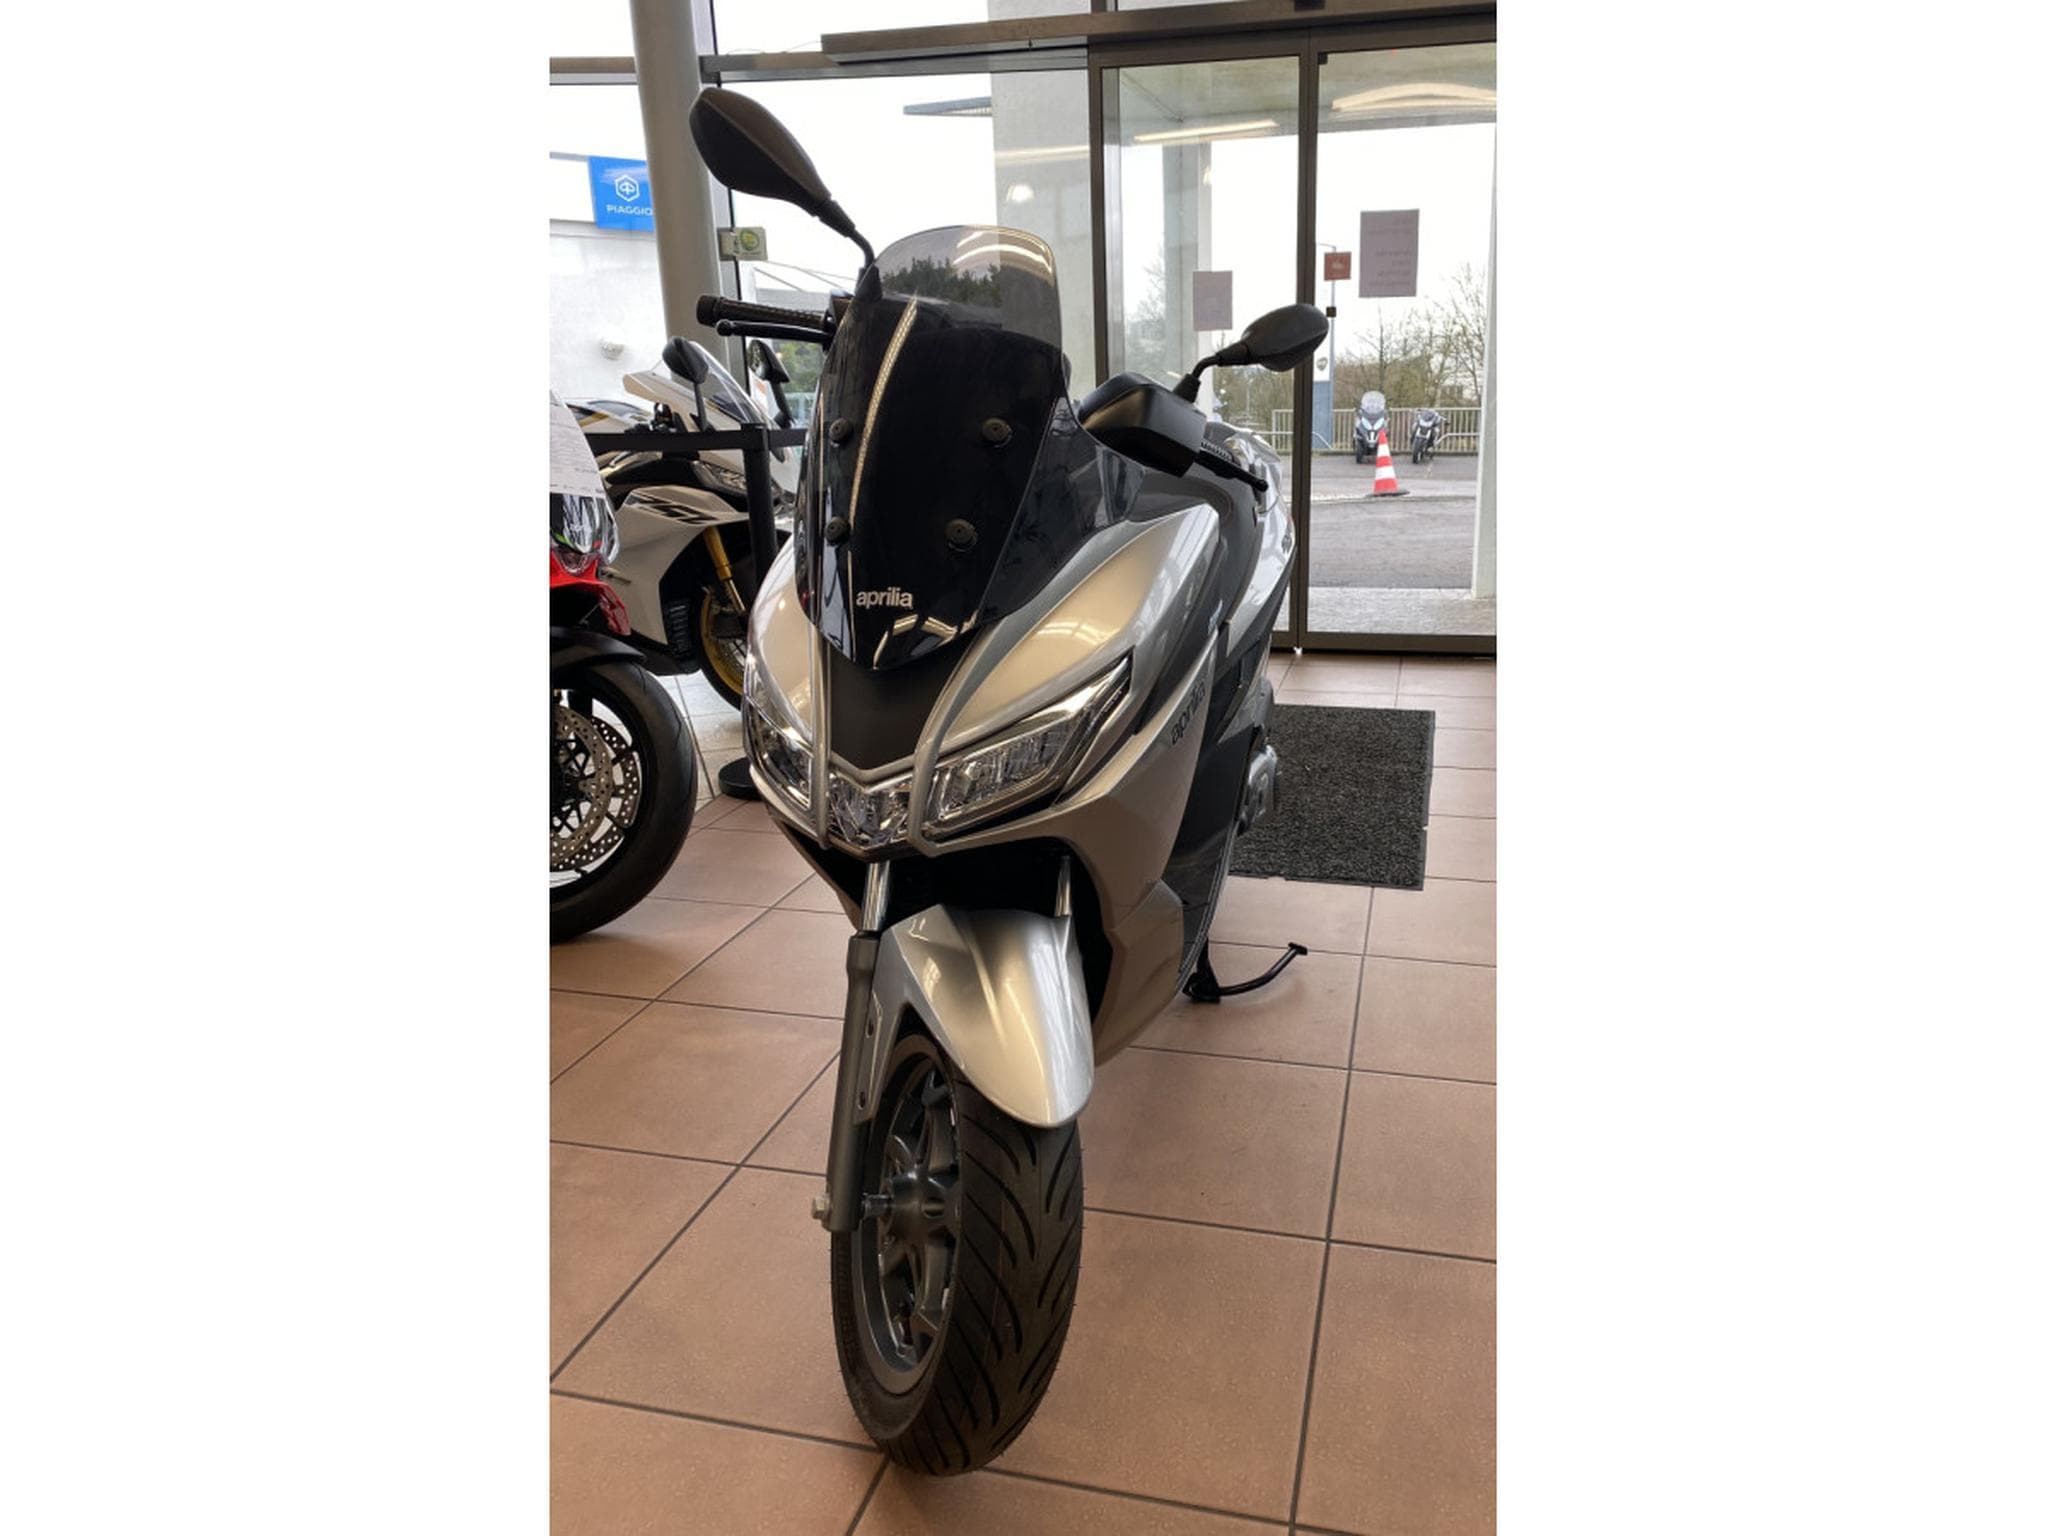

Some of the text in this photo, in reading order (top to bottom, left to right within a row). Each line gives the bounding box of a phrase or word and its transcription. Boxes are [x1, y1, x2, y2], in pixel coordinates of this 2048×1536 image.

[606, 204, 654, 216] PIAGGIO
[856, 587, 914, 609] aprilia
[1172, 682, 1206, 745] aprilia
